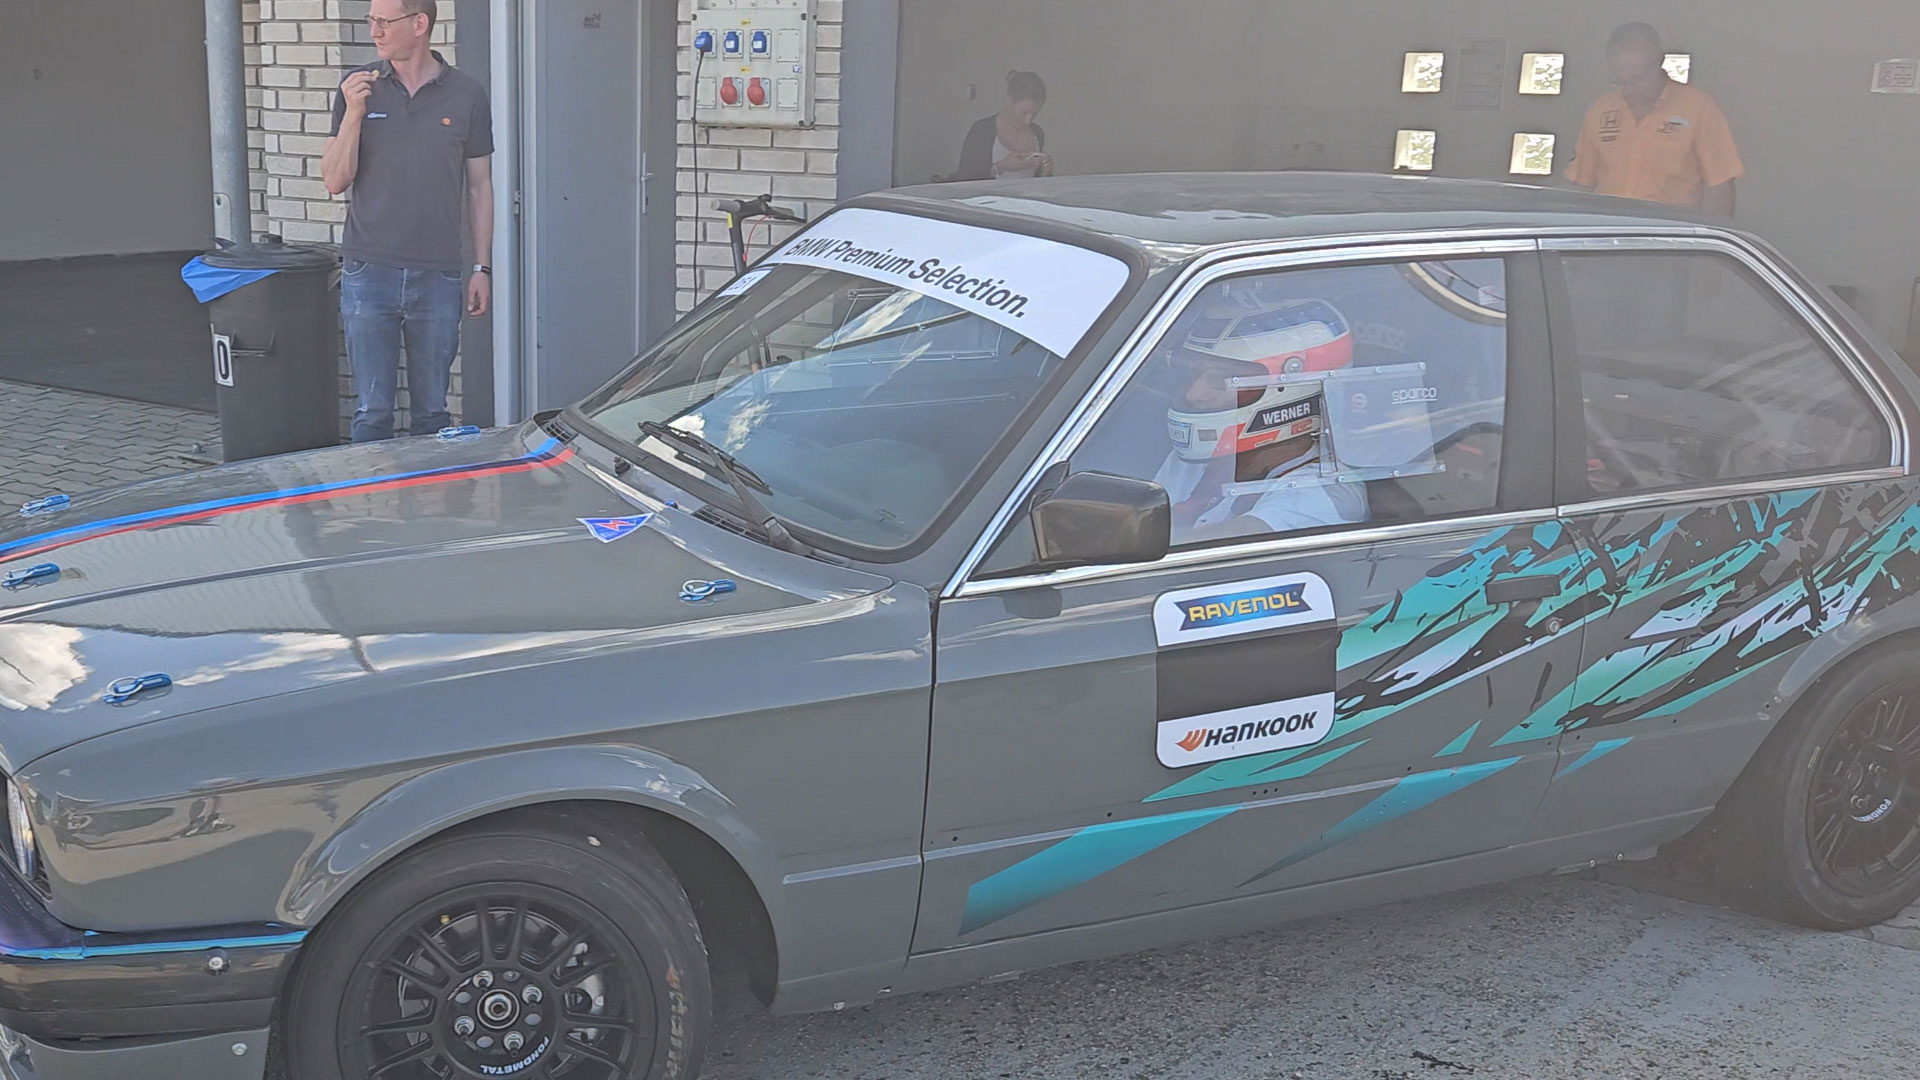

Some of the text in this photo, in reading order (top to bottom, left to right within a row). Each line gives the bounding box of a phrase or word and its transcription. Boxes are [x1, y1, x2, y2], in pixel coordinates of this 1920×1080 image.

[786, 238, 1031, 318] BMW Premium Selection.
[1392, 386, 1437, 403] sparco
[1262, 402, 1311, 426] WERNER
[1188, 591, 1300, 622] RAVENOL
[480, 1036, 550, 1075] FONDMETAL
